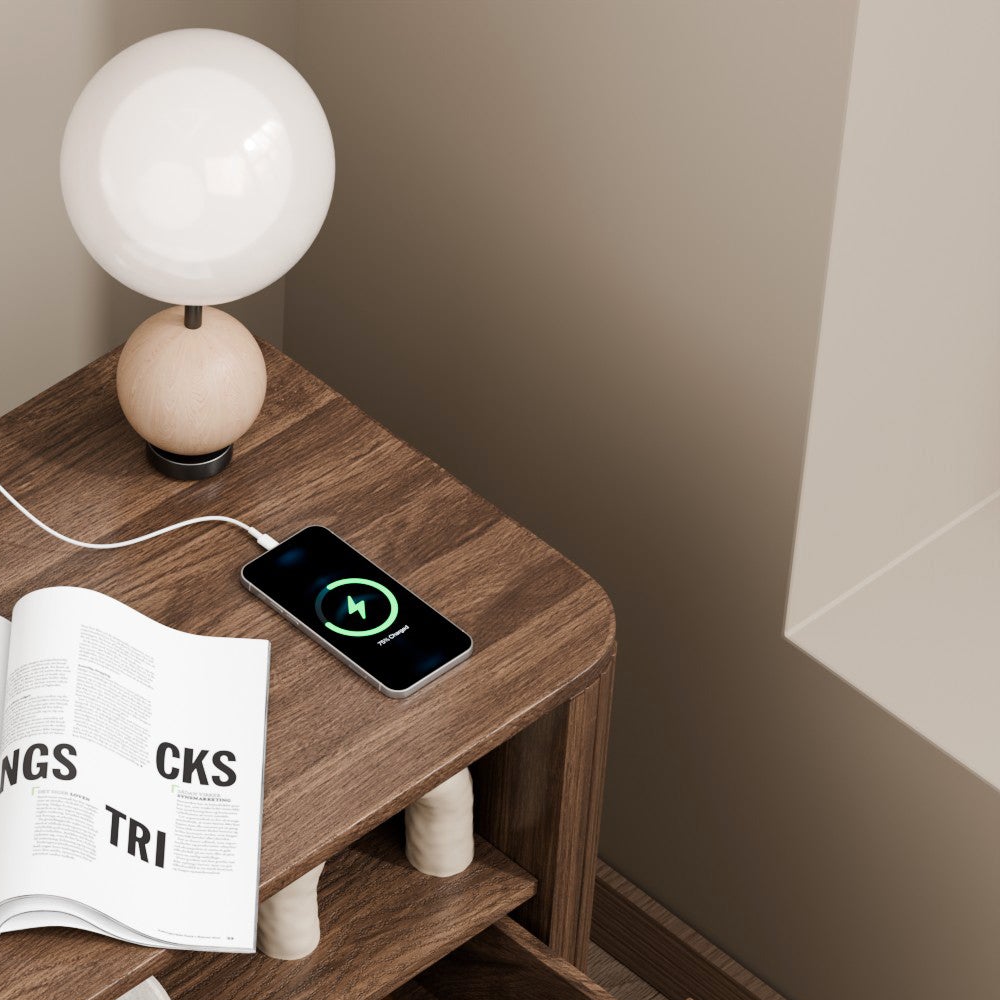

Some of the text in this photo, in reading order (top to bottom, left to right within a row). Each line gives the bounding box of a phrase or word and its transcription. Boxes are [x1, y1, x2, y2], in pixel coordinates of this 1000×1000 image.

[377, 624, 409, 646] 75% Charged
[0, 744, 77, 794] NGS
[156, 742, 236, 786] CKS
[70, 792, 90, 801] LOVEN
[106, 805, 166, 868] TRI
